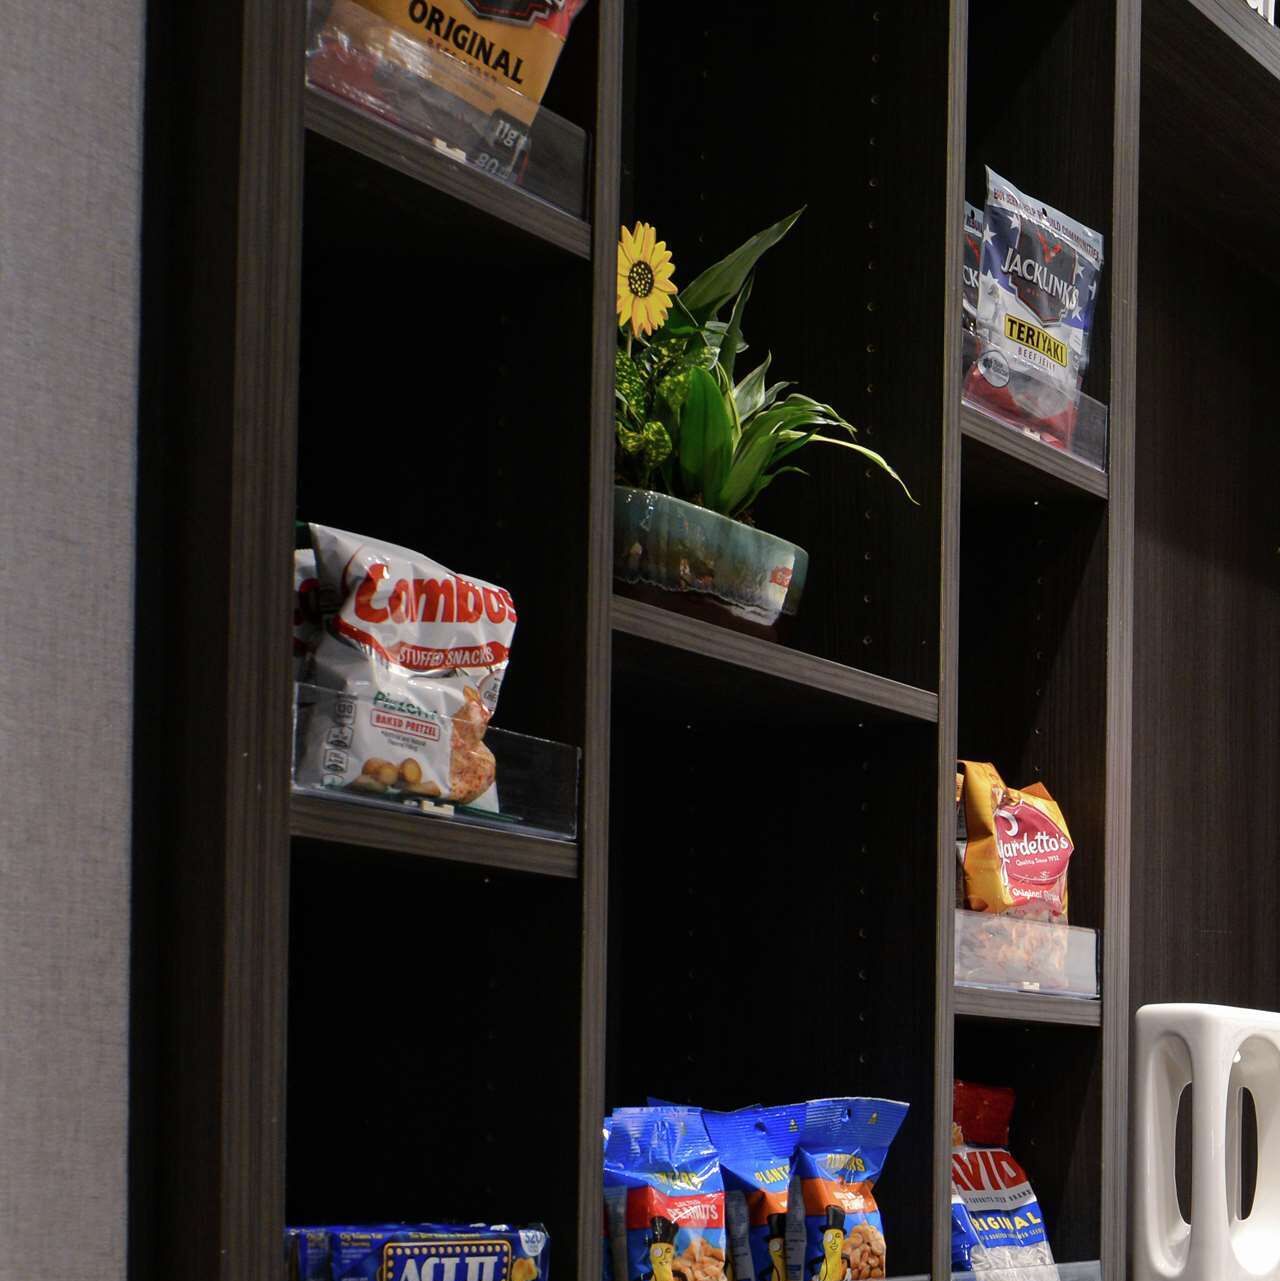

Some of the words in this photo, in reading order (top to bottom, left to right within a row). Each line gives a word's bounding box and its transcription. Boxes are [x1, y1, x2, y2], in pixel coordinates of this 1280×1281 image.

[408, 0, 525, 84] ORIGINAL
[1007, 317, 1065, 363] TERIYAKI
[354, 563, 517, 623] Combos
[399, 648, 444, 665] STUFFED
[447, 647, 495, 665] SNACKS
[375, 714, 402, 728] BAKED
[405, 720, 436, 736] PRETZEL
[755, 1165, 790, 1184] PLANT
[952, 1151, 1026, 1191] AVID
[971, 1212, 1041, 1232] RIGINAL
